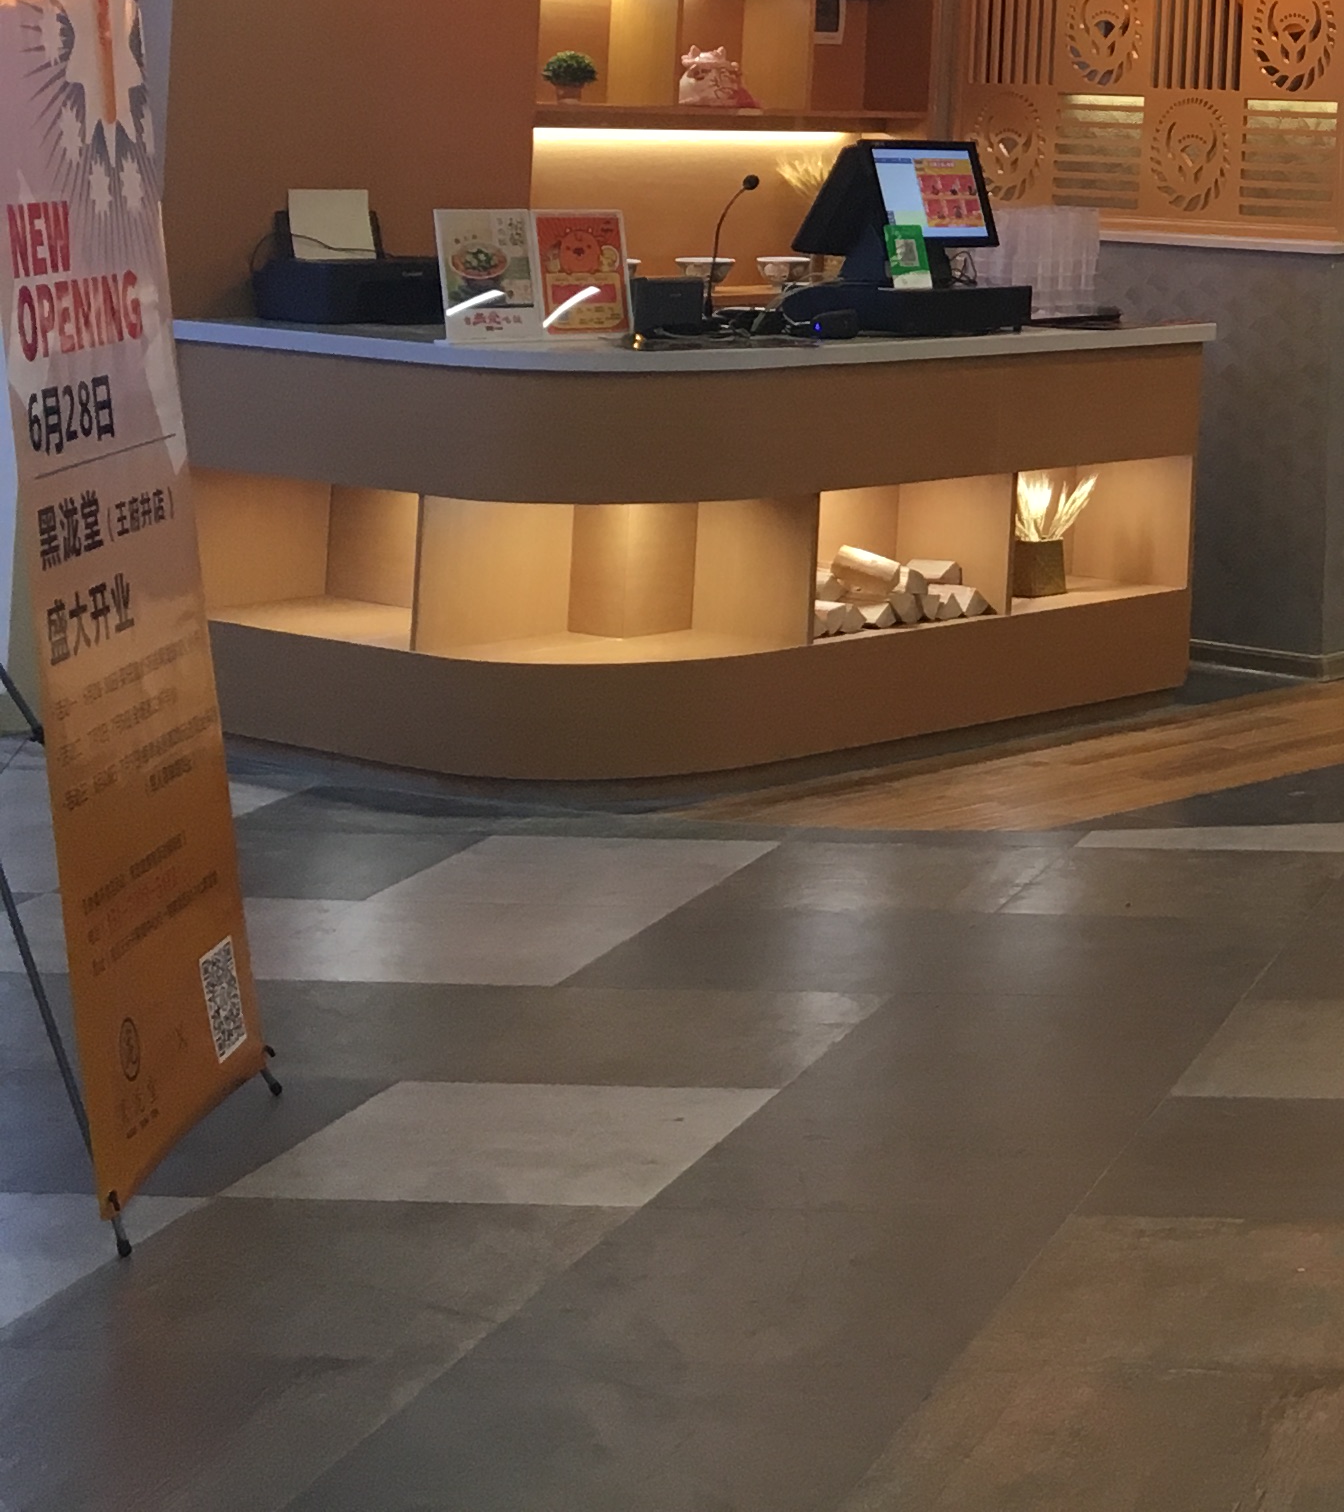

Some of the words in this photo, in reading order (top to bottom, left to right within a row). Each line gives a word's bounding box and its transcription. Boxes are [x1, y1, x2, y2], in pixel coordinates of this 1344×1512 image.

[6, 199, 72, 280] NEW
[17, 268, 144, 363] OPENING
[28, 374, 117, 455] 6月28日
[45, 572, 136, 667] 盛大开业
